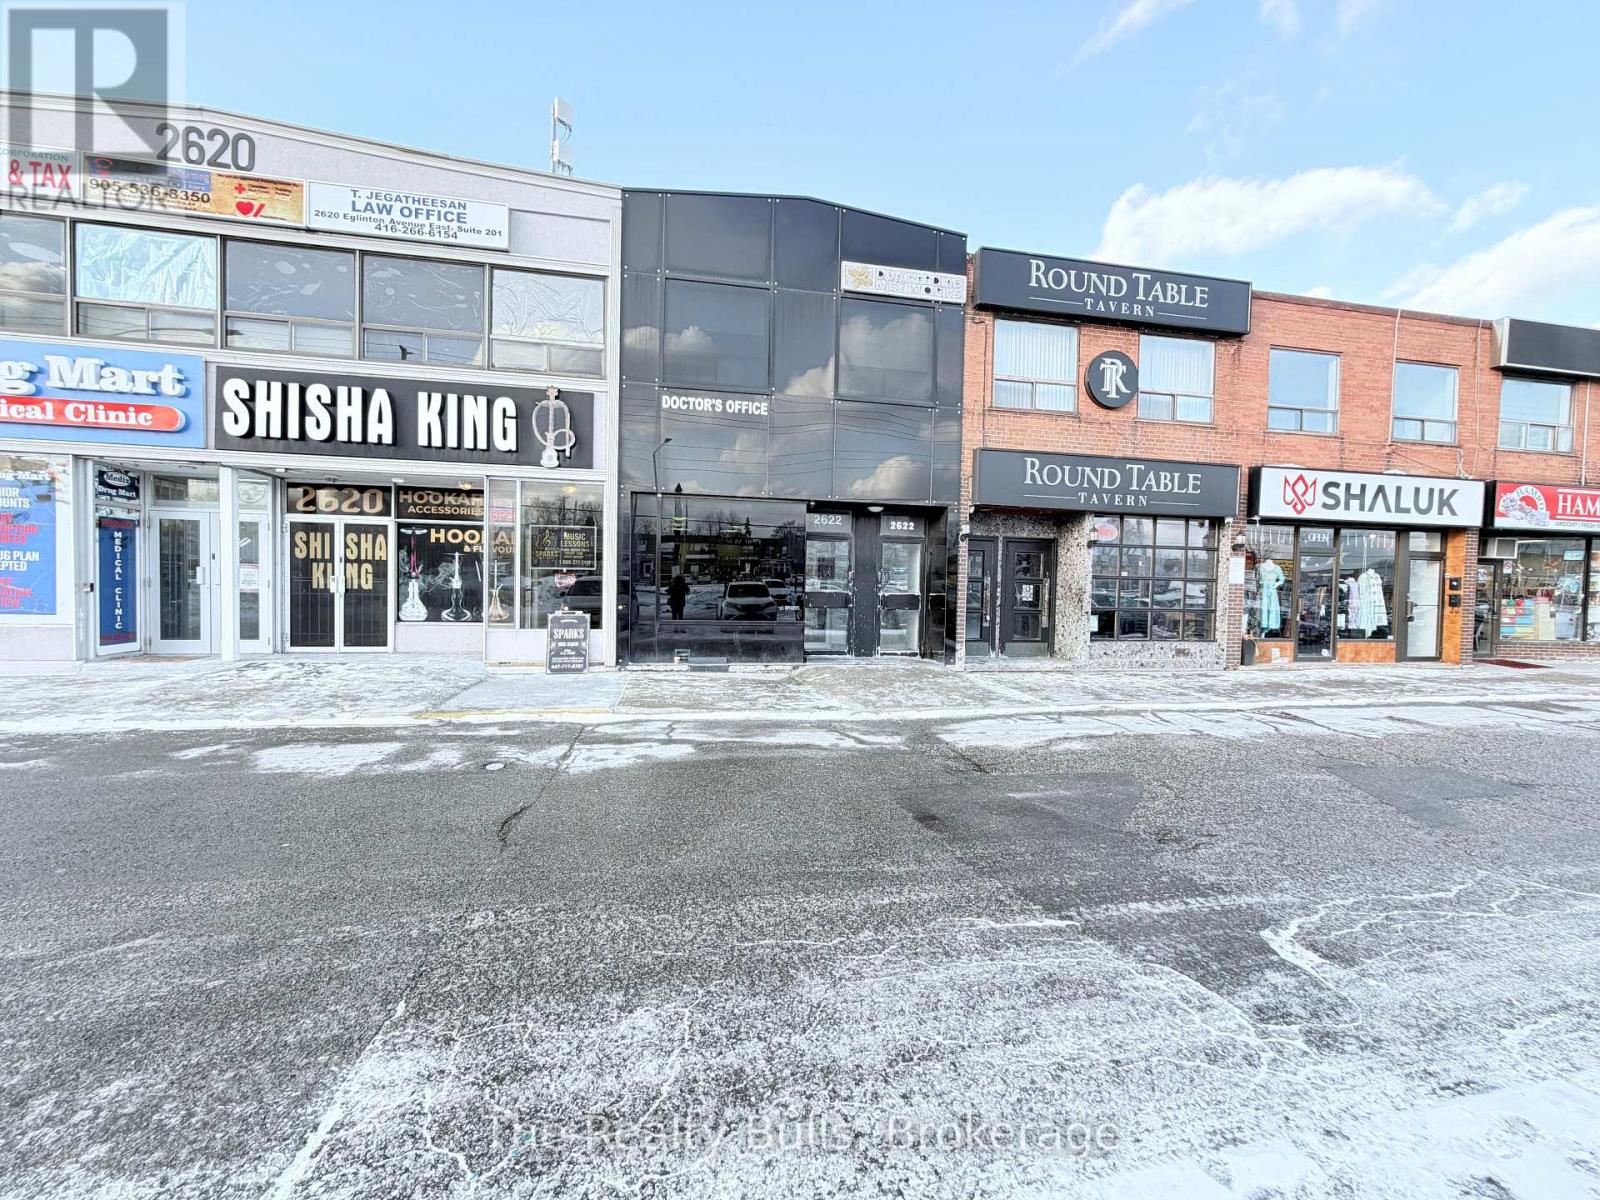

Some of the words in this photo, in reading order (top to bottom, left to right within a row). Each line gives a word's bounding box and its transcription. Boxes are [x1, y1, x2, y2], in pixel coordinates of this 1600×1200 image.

[155, 122, 256, 172] 2620
[8, 159, 24, 185] &
[28, 161, 72, 190] TAX
[89, 178, 211, 203] 905-536-8350
[351, 189, 361, 199] T.
[366, 191, 467, 211] JEGATHEESAN
[314, 209, 340, 220] 2620
[343, 213, 385, 224] Eglinton
[389, 217, 425, 229] Avenue
[457, 226, 482, 236] Suite
[485, 229, 502, 237] 201
[351, 200, 393, 216] LAW
[399, 206, 467, 224] OFFICE
[374, 223, 458, 239] 416-266-6154
[1029, 259, 1127, 298] ROUND
[1132, 272, 1209, 308] TABLE
[1084, 298, 1155, 317] TAVERN
[44, 355, 186, 397] Mart
[64, 402, 153, 426] Clinic
[222, 378, 393, 445] SHISHA
[417, 391, 518, 452] KING
[662, 395, 722, 412] DOCTOR'S
[726, 400, 768, 415] OFFICE
[1024, 457, 1121, 489] ROUND
[1126, 464, 1201, 494] TABLE
[295, 486, 384, 514] 2620
[1079, 492, 1148, 506] TAVERN
[1321, 481, 1460, 516] SHALUK
[408, 505, 484, 517] ACCESSORIES
[814, 515, 842, 525] 2622
[564, 531, 586, 541] MUSIC
[890, 521, 915, 530] 2622
[12, 551, 40, 561] PLAN
[114, 531, 123, 580] MEDICAL
[115, 587, 123, 629] CLINIC
[553, 628, 584, 639] SPARKS
